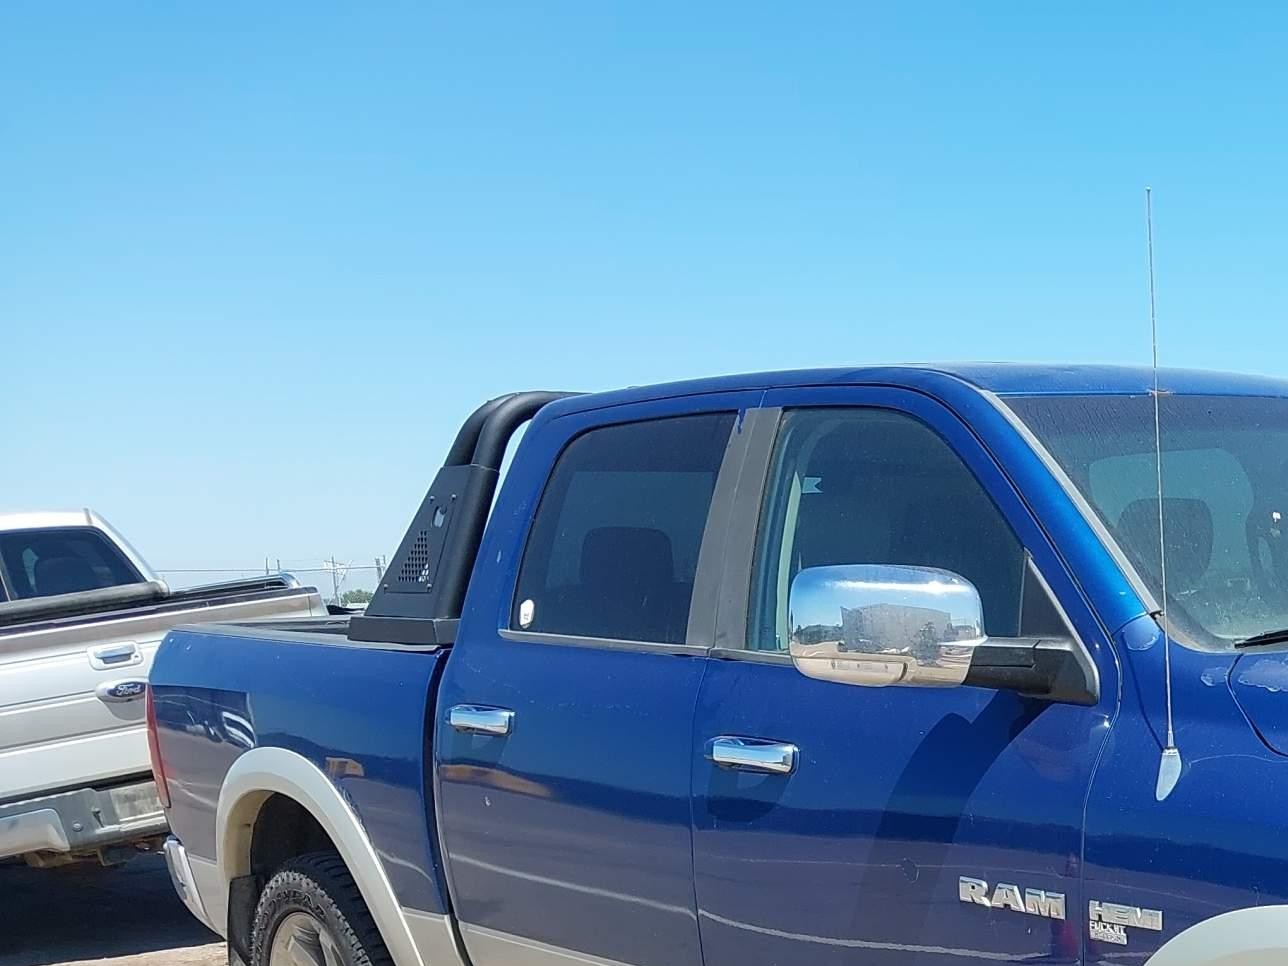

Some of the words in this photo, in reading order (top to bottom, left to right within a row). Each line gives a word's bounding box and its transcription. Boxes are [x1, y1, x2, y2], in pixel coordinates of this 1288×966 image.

[116, 683, 141, 696] Ford
[959, 876, 1066, 920] RAM
[1089, 900, 1163, 931] HEMI
